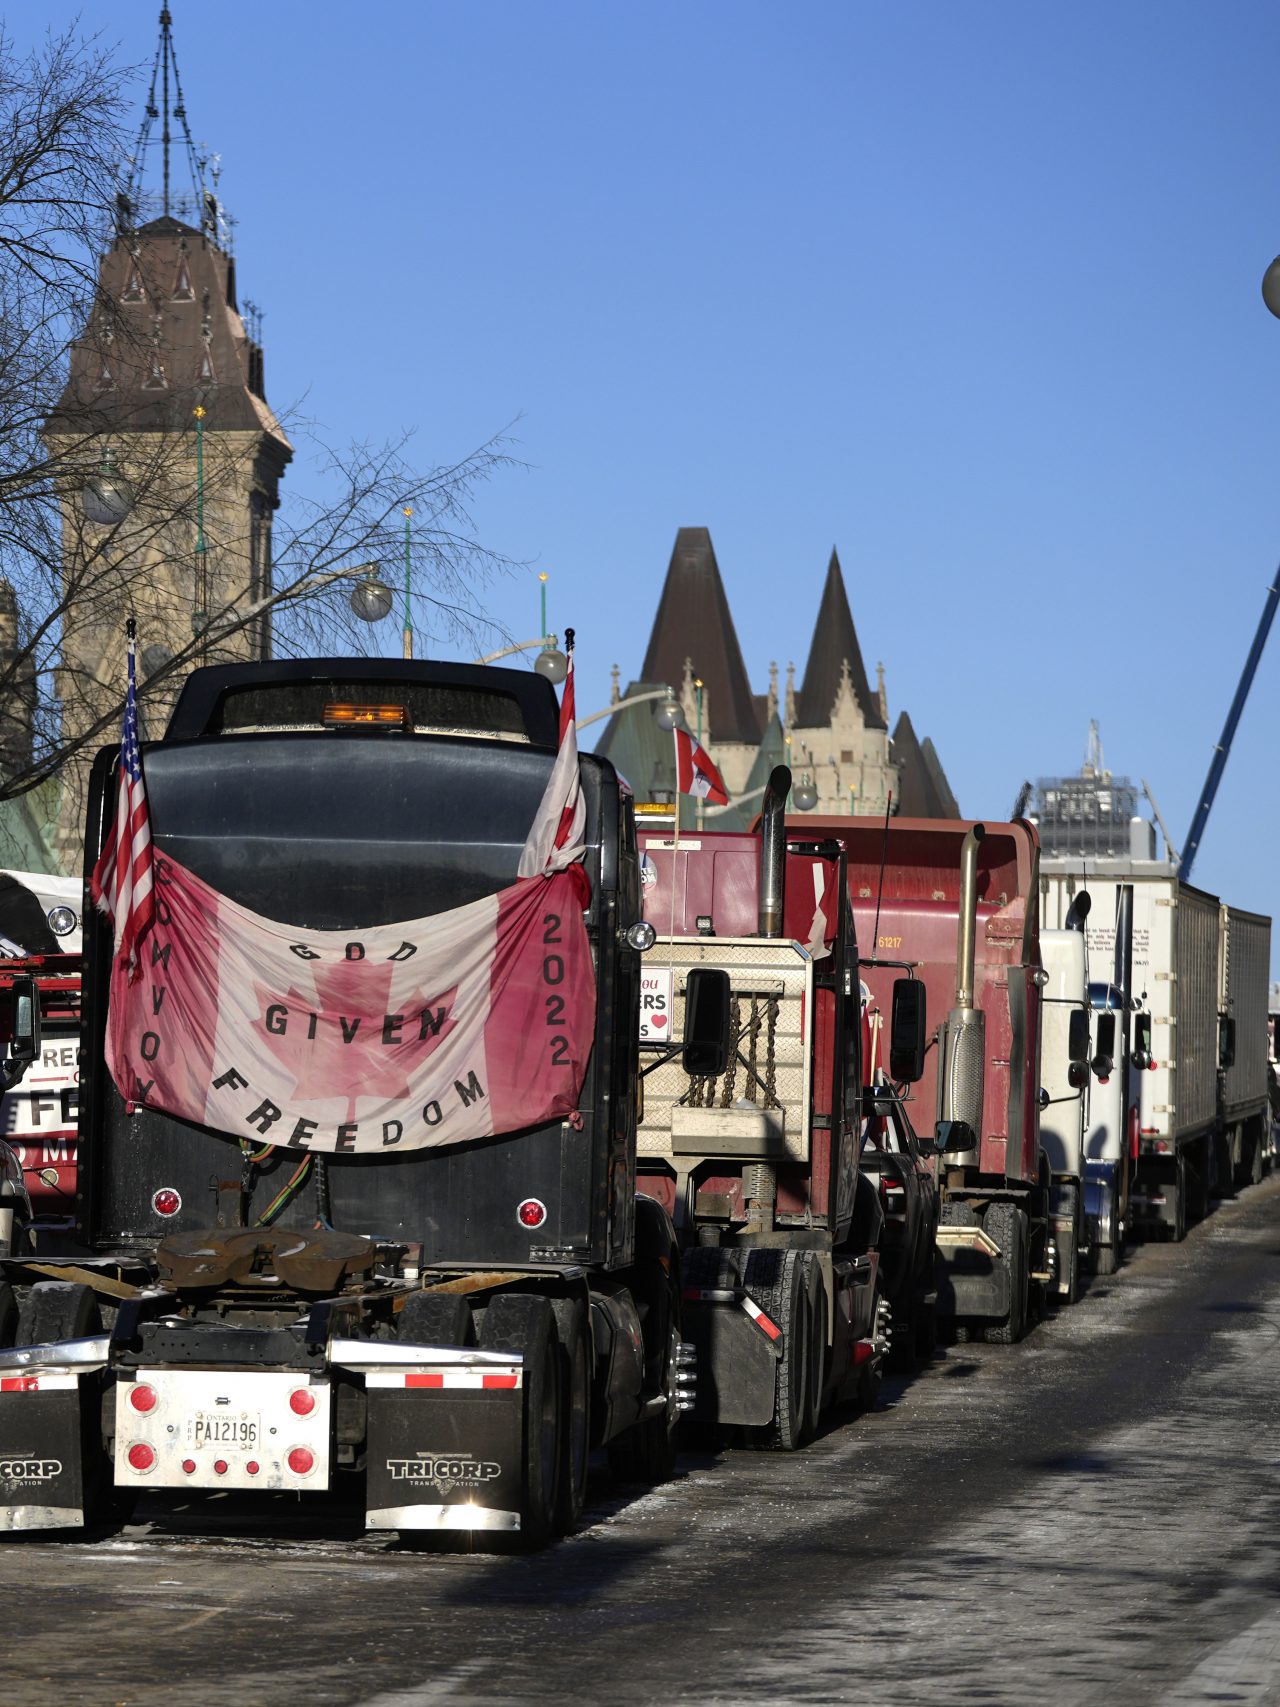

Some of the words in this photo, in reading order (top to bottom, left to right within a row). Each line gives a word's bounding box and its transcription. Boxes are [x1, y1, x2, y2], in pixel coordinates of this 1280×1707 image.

[289, 941, 418, 962] GOD
[878, 936, 902, 948] 61217
[134, 857, 174, 1100] CONVOY
[542, 914, 571, 1066] 2022
[265, 1004, 446, 1045] GIVEN
[212, 1067, 488, 1152] FREEDOM
[195, 1421, 257, 1442] PA12196
[386, 1459, 502, 1481] TRICORP
